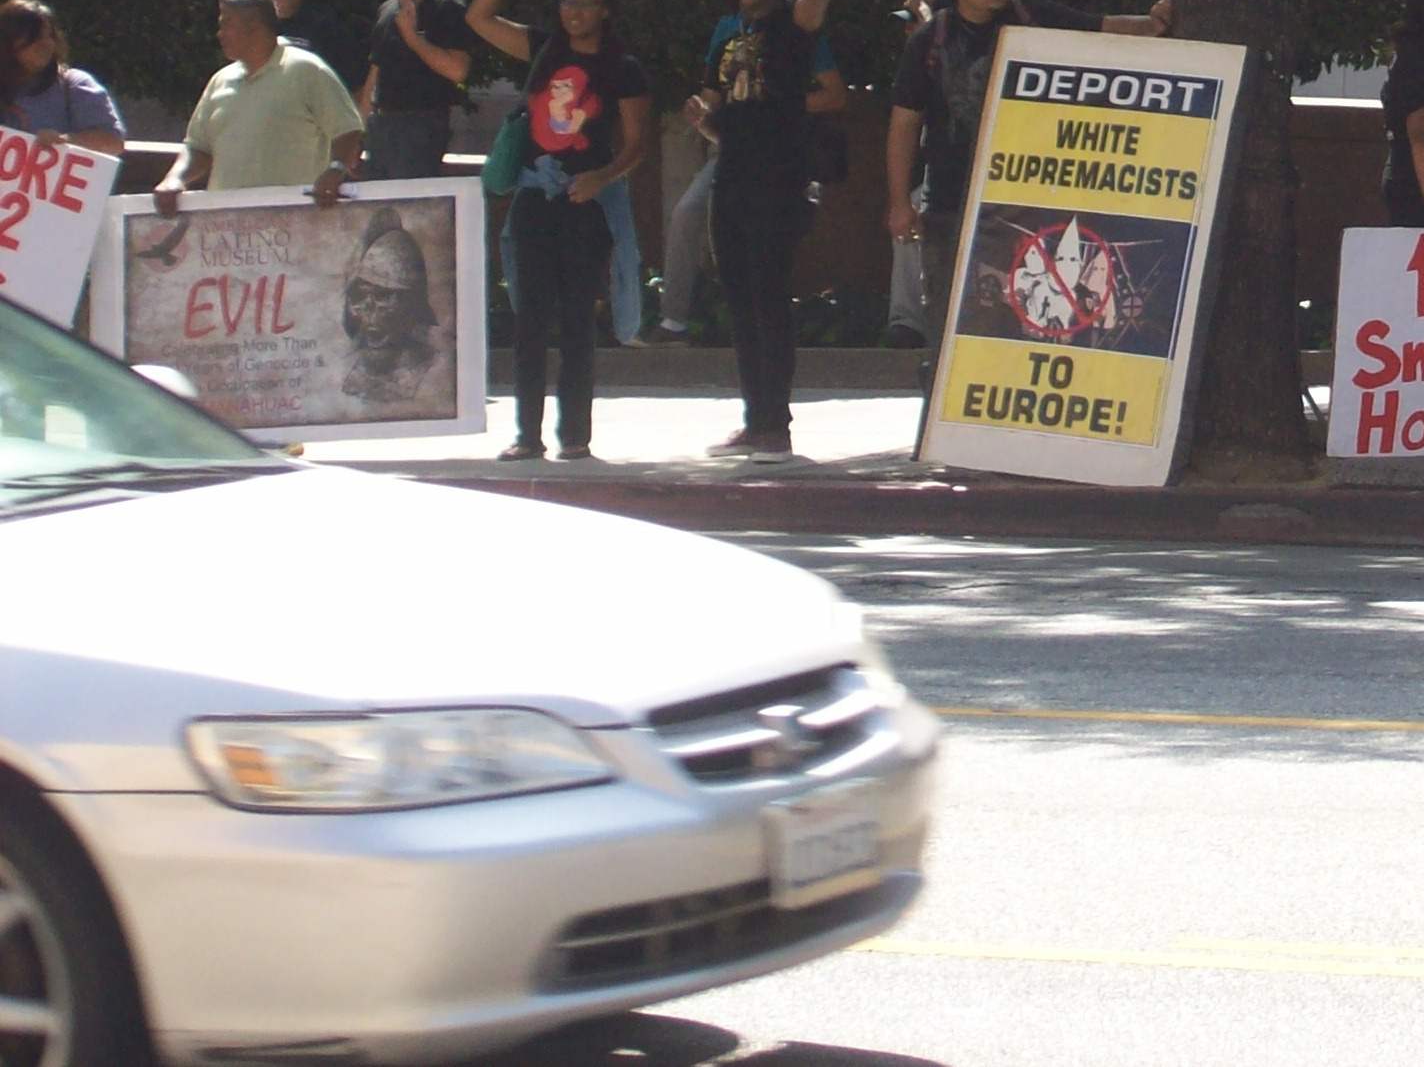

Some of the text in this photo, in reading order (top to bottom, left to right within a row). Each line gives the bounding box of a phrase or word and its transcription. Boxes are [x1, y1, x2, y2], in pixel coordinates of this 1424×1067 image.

[1015, 67, 1204, 112] DEPORT
[1056, 119, 1141, 156] WHITE
[0, 132, 95, 214] ORE
[988, 153, 1198, 200] SUPREMACISTS
[201, 230, 291, 251] LATINO
[201, 248, 294, 267] MUSEUM
[184, 274, 294, 340] EVIL
[244, 338, 278, 351] More
[283, 336, 318, 350] Than
[244, 356, 311, 371] Genocide
[1029, 353, 1073, 388] TO
[964, 384, 1127, 436] EUROPE!
